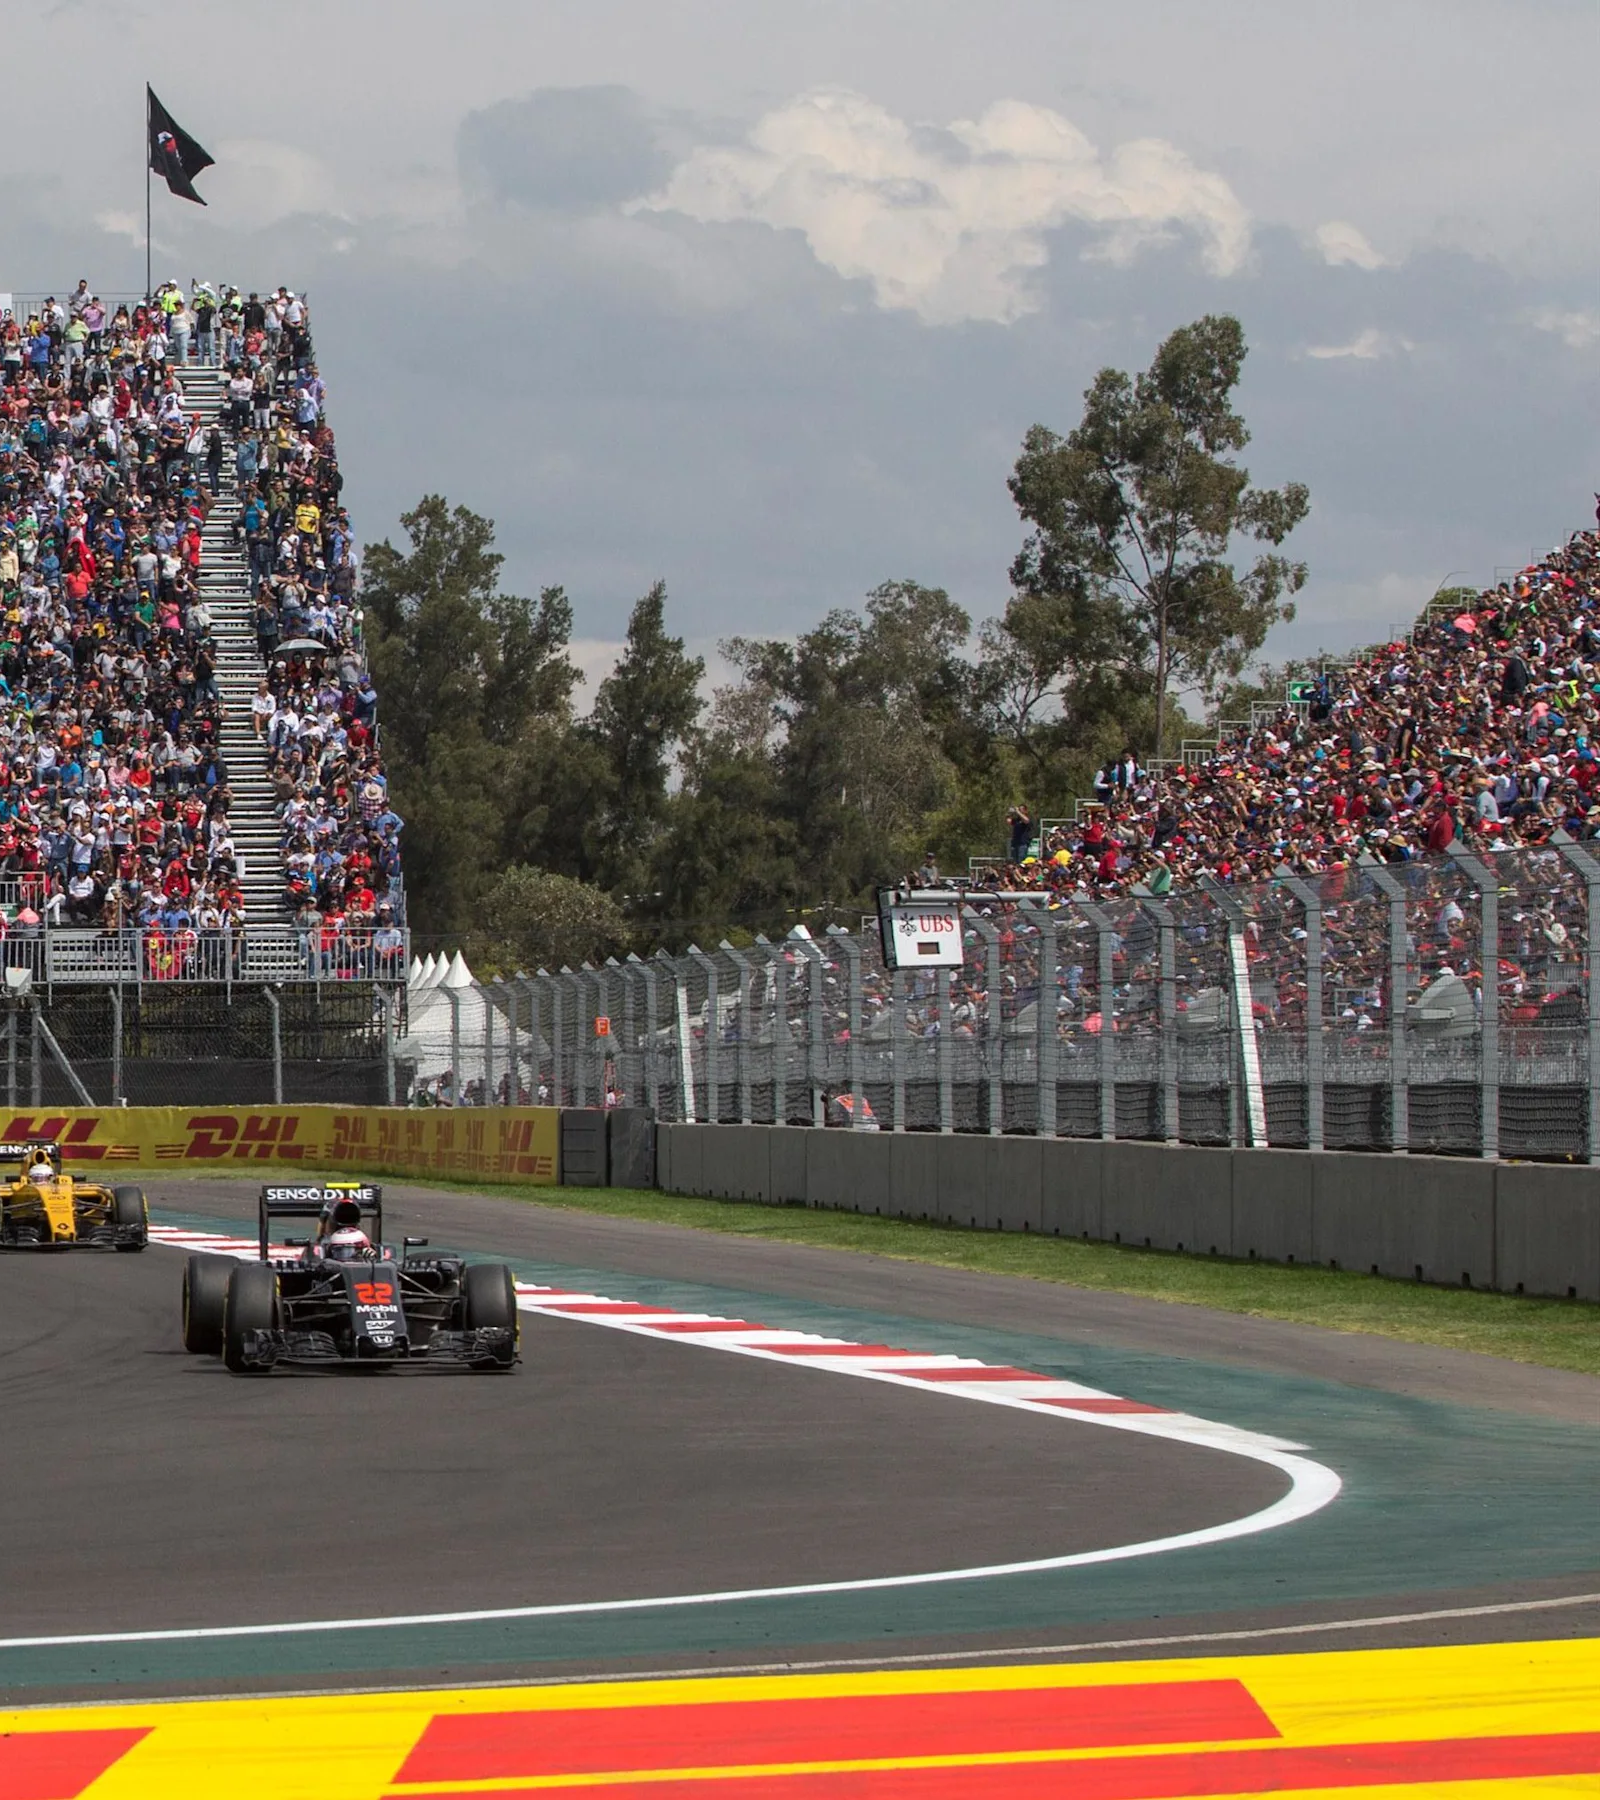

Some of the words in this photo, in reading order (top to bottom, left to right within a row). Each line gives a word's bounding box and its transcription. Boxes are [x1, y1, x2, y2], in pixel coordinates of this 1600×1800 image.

[919, 914, 955, 933] UBS
[185, 1115, 308, 1159] DHL
[353, 1282, 394, 1304] 22
[355, 1304, 399, 1313] Mobil
